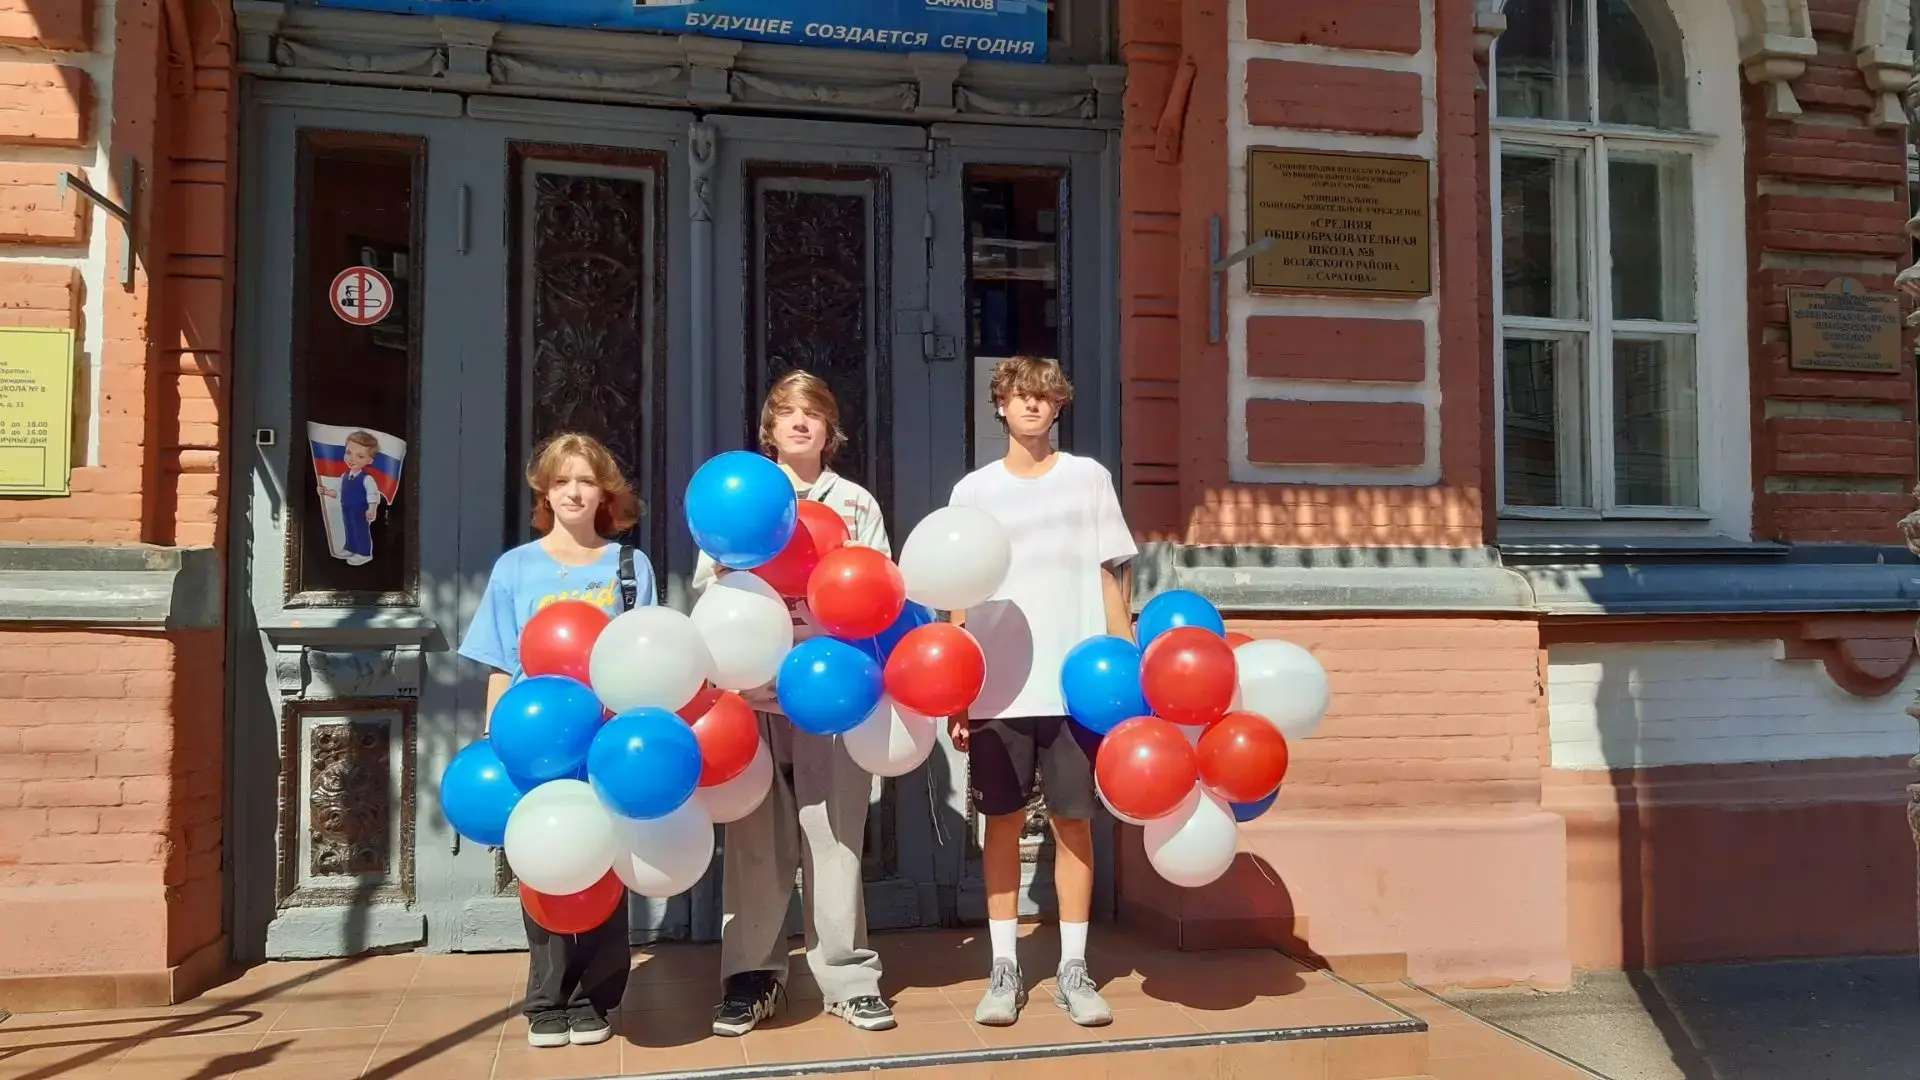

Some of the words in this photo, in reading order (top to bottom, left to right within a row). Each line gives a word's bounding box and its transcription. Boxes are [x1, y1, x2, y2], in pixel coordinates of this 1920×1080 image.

[685, 12, 793, 35] БУДУЩЕЕ
[805, 22, 928, 46] СОЗДАЕТСЯ
[941, 34, 1035, 55] СЕГОДНЯ
[1310, 218, 1372, 230] «СРЕДНЯЯ
[1265, 229, 1417, 245] ОБЩЕОБРАЗОВАТЕЛЬНАЯ
[1308, 245, 1354, 257] ШКОЛА
[1358, 248, 1375, 257] №8
[1283, 257, 1353, 269] ВОЛЖСКОГО
[1356, 259, 1400, 271] РАЙОНА
[1316, 272, 1378, 283] САРАТОВА»
